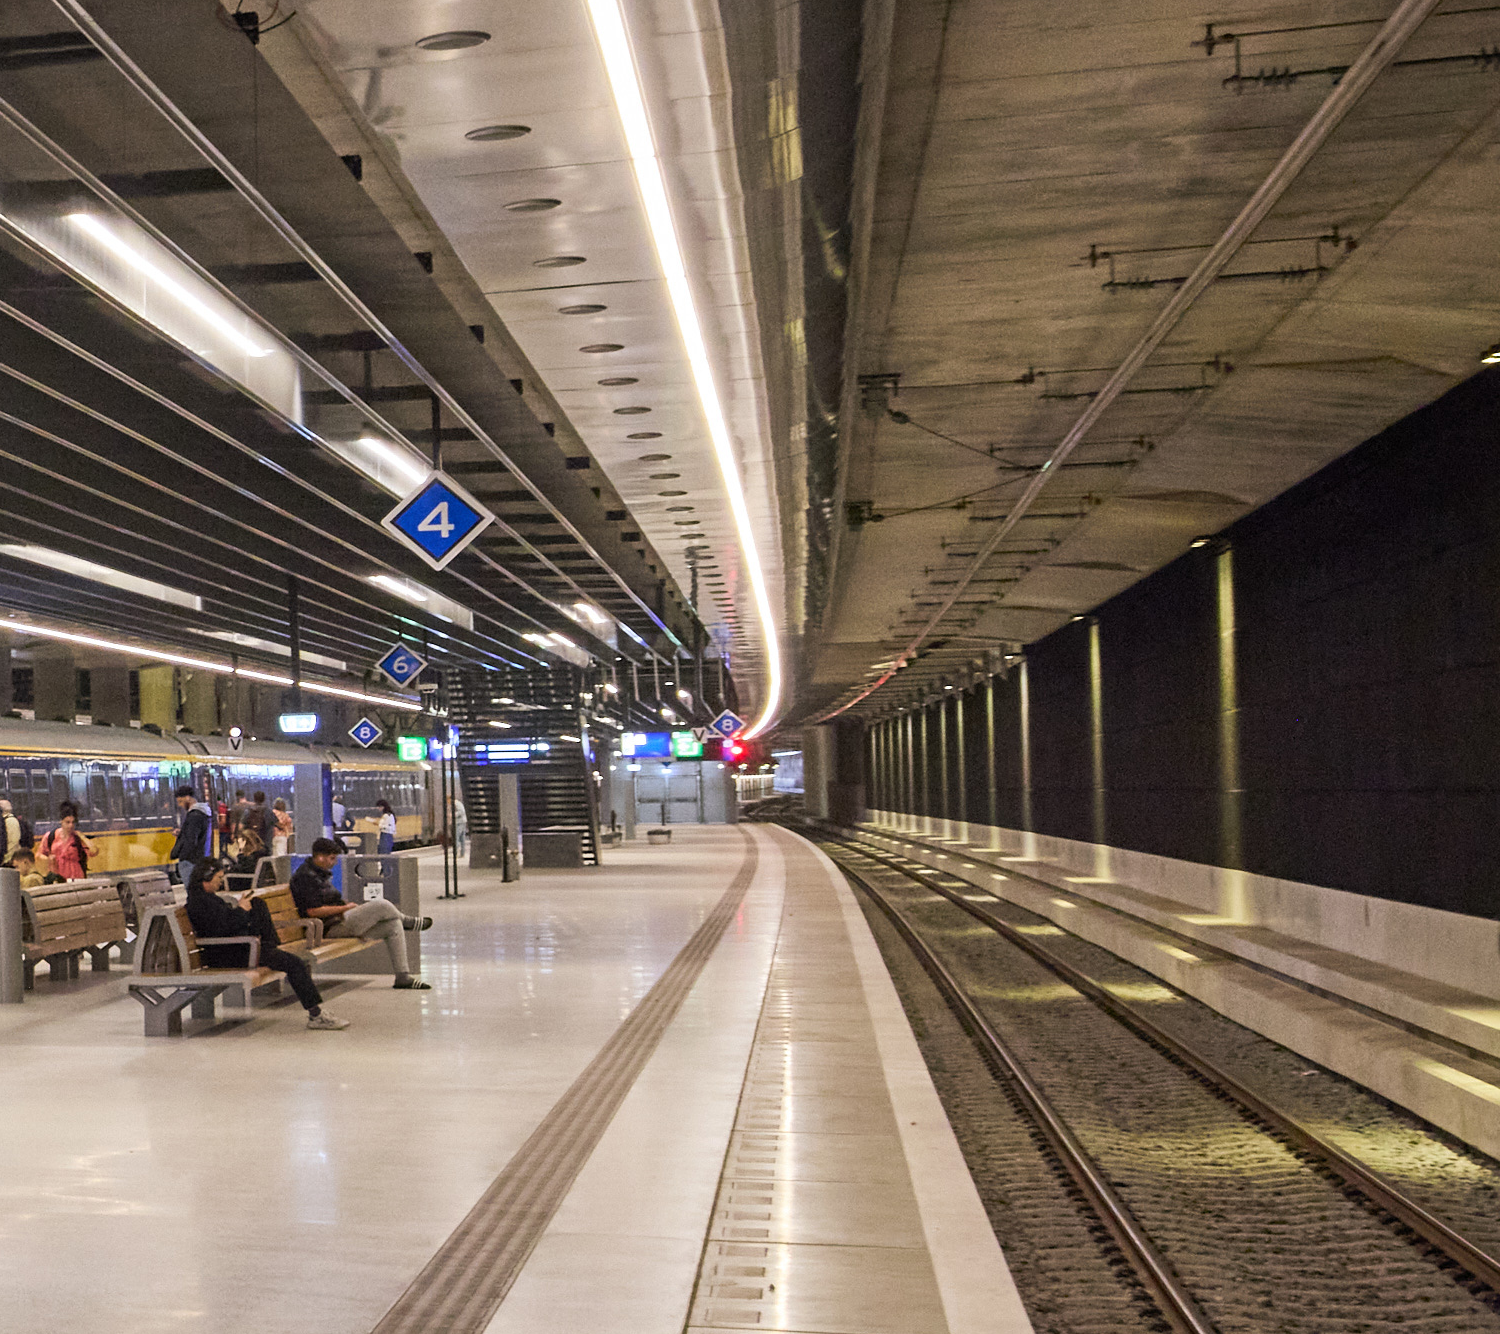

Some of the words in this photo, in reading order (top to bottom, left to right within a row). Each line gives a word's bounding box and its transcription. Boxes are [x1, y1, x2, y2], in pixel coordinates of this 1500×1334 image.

[417, 501, 455, 539] 4
[393, 656, 408, 673] 6
[722, 719, 733, 732] 8
[360, 726, 371, 739] 8
[693, 729, 705, 742] V
[230, 738, 241, 750] V
